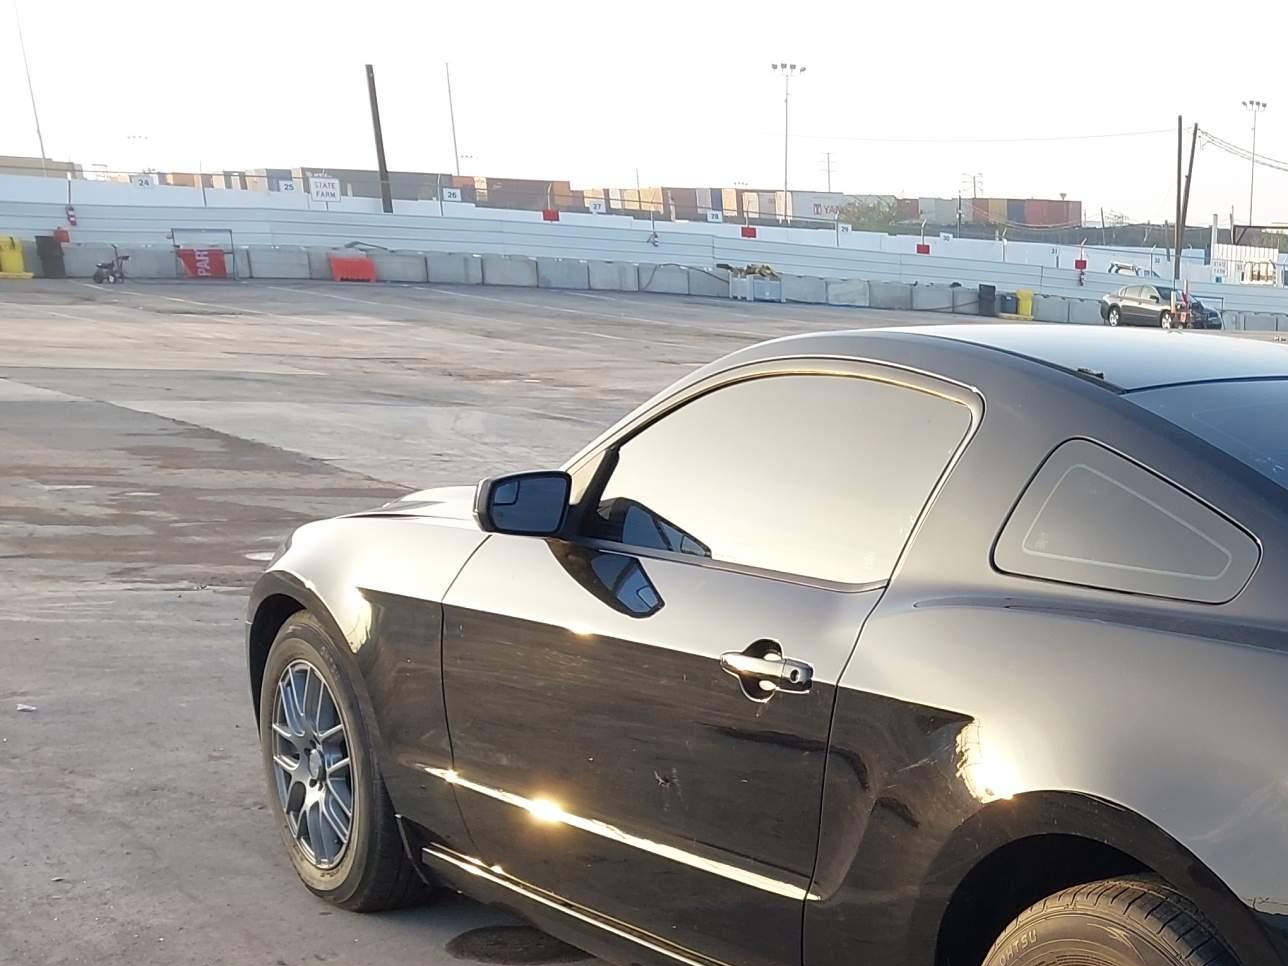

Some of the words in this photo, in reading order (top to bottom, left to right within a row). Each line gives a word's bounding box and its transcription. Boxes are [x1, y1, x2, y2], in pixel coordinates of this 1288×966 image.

[284, 183, 294, 191] 25
[447, 191, 457, 199] 26
[999, 929, 1037, 966] OHTSU
